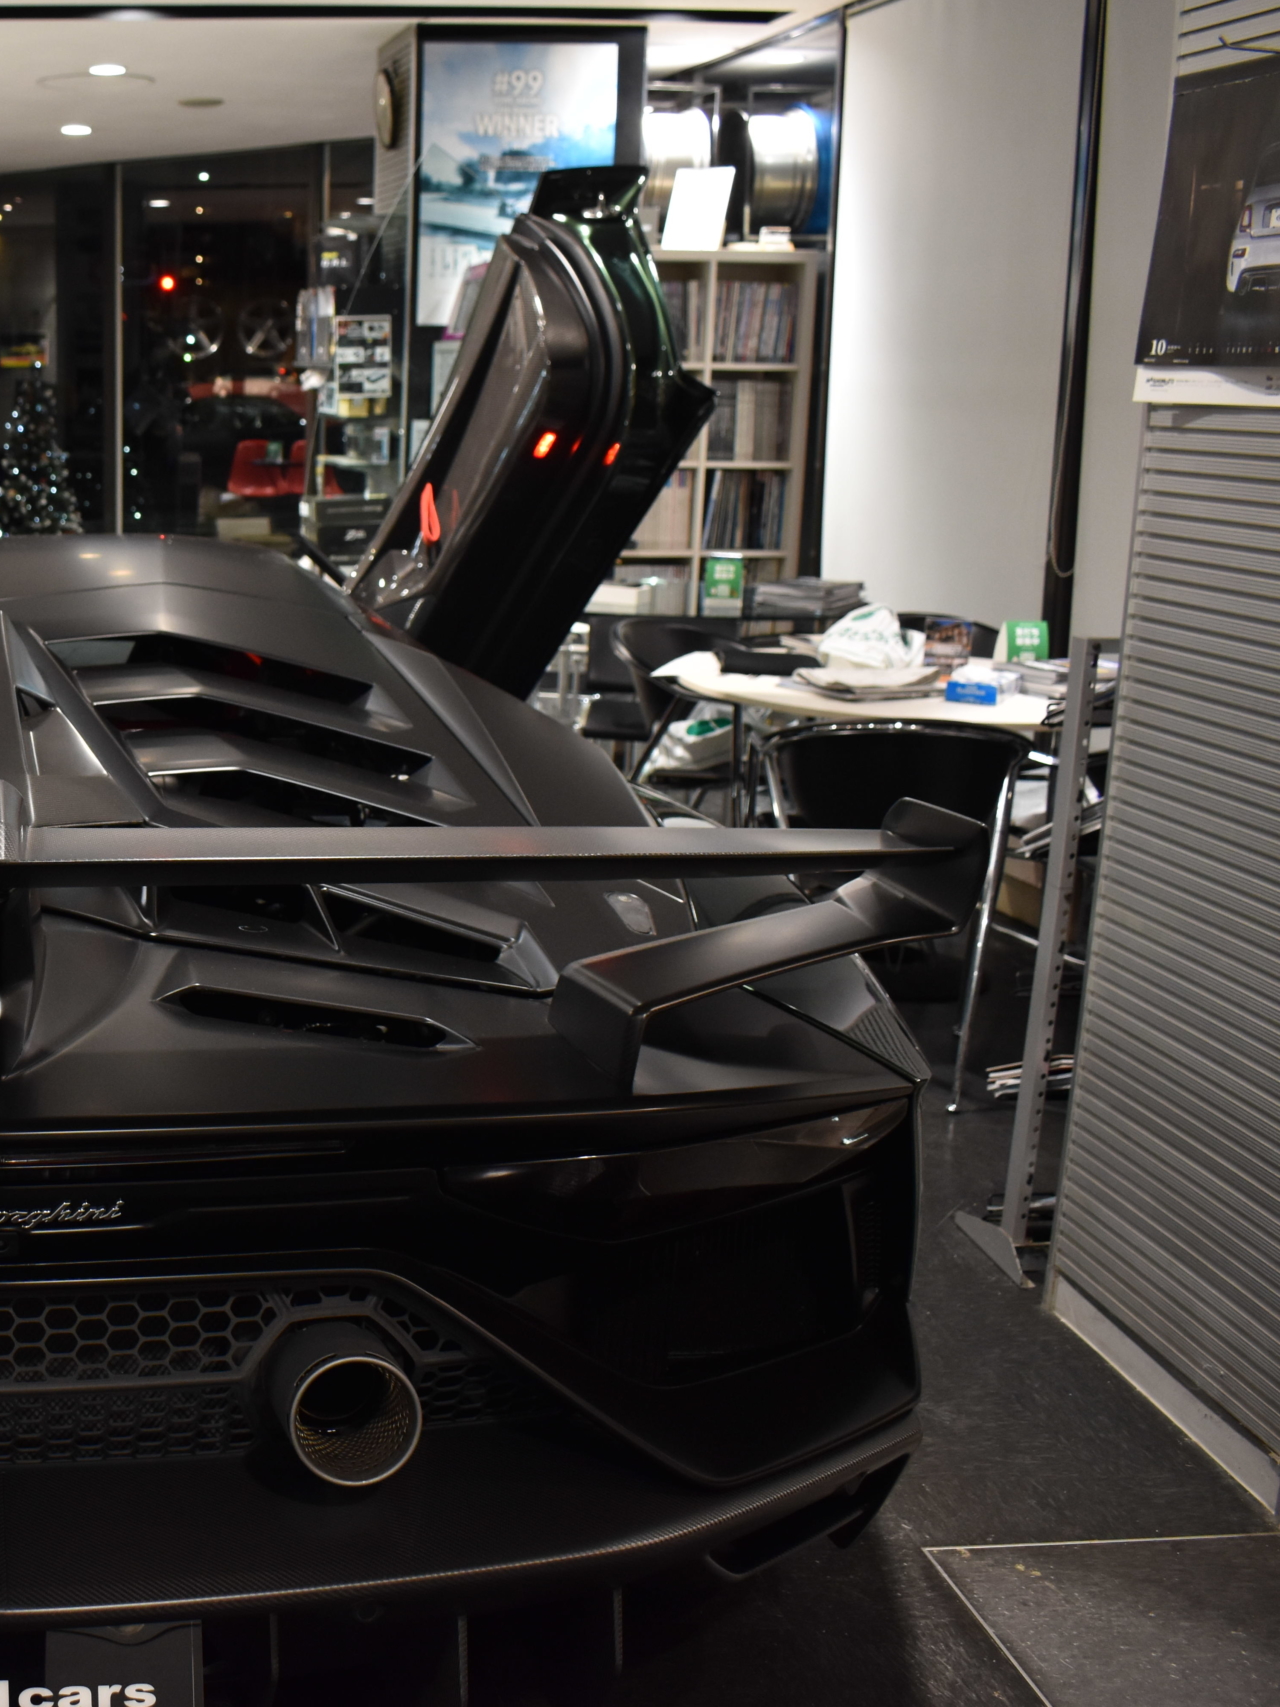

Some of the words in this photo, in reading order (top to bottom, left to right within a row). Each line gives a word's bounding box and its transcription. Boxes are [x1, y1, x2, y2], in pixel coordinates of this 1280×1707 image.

[494, 69, 544, 96] #99
[476, 114, 559, 138] WINNER
[1149, 338, 1167, 356] 10
